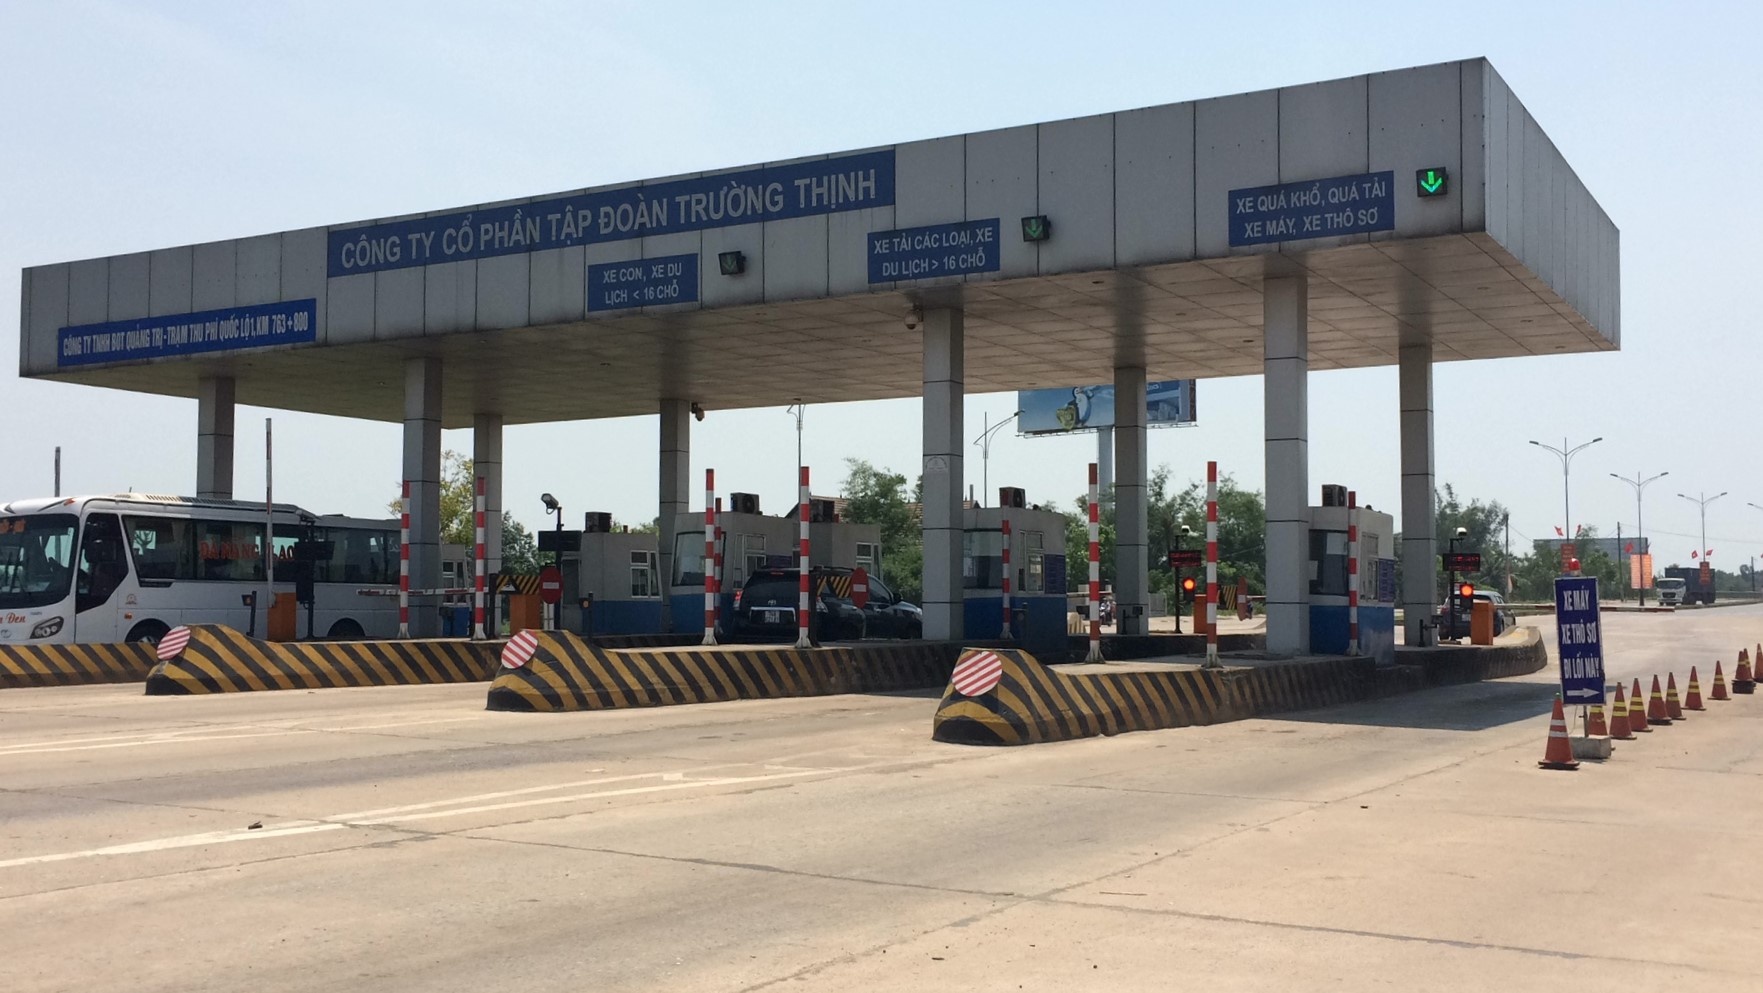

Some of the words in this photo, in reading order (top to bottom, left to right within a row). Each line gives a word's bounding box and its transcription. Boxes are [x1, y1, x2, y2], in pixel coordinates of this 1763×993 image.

[1236, 197, 1254, 214] XE
[1257, 190, 1287, 212] QUÁ
[1290, 182, 1325, 207] KHỔ,
[1328, 181, 1359, 204] QUÁ
[1363, 177, 1386, 199] TẢI
[341, 233, 400, 269] CÔNG
[408, 230, 435, 259] TY
[442, 214, 474, 255] CỔ
[480, 208, 541, 250] PHẦN
[547, 204, 592, 245] TẬP
[598, 193, 668, 235] ĐOÀN
[675, 180, 784, 224] TRƯỜNG
[794, 168, 876, 209] THỊNH
[1244, 221, 1262, 238] XE
[1266, 216, 1296, 236] MÁY,
[1303, 215, 1321, 232] XE
[1324, 208, 1354, 229] THÔ
[1357, 206, 1378, 225] SƠ
[874, 239, 890, 254] XE
[893, 232, 911, 252] TẢI
[914, 231, 940, 250] CÁC
[942, 230, 973, 248] LOẠI,
[975, 227, 993, 243] XE
[603, 270, 617, 284] XE
[619, 267, 647, 282] CON,
[651, 264, 665, 279] XE
[667, 262, 682, 277] DU
[882, 262, 898, 276] DU
[902, 258, 929, 277] LỊCH
[931, 260, 939, 270] >
[942, 255, 956, 270] 16
[959, 247, 986, 269] CHỖ
[605, 289, 628, 306] LỊCH
[633, 290, 640, 299] <
[643, 287, 655, 300] 16
[656, 279, 679, 299] CHỖ
[63, 334, 82, 356] CÔNG
[83, 335, 92, 354] TY
[92, 333, 111, 353] TNHH
[111, 331, 126, 351] BOT
[189, 323, 204, 343] THU
[205, 317, 218, 342] PHÍ
[219, 314, 240, 342] QUỐC
[240, 313, 250, 340] LỘ
[1563, 590, 1573, 611] XE
[1573, 586, 1589, 611] MÁY
[1561, 623, 1571, 644] XE
[1571, 618, 1586, 644] THÔ
[1586, 621, 1597, 643] SƠ
[1572, 651, 1585, 679] LỐI
[1585, 653, 1600, 678] NÀY
